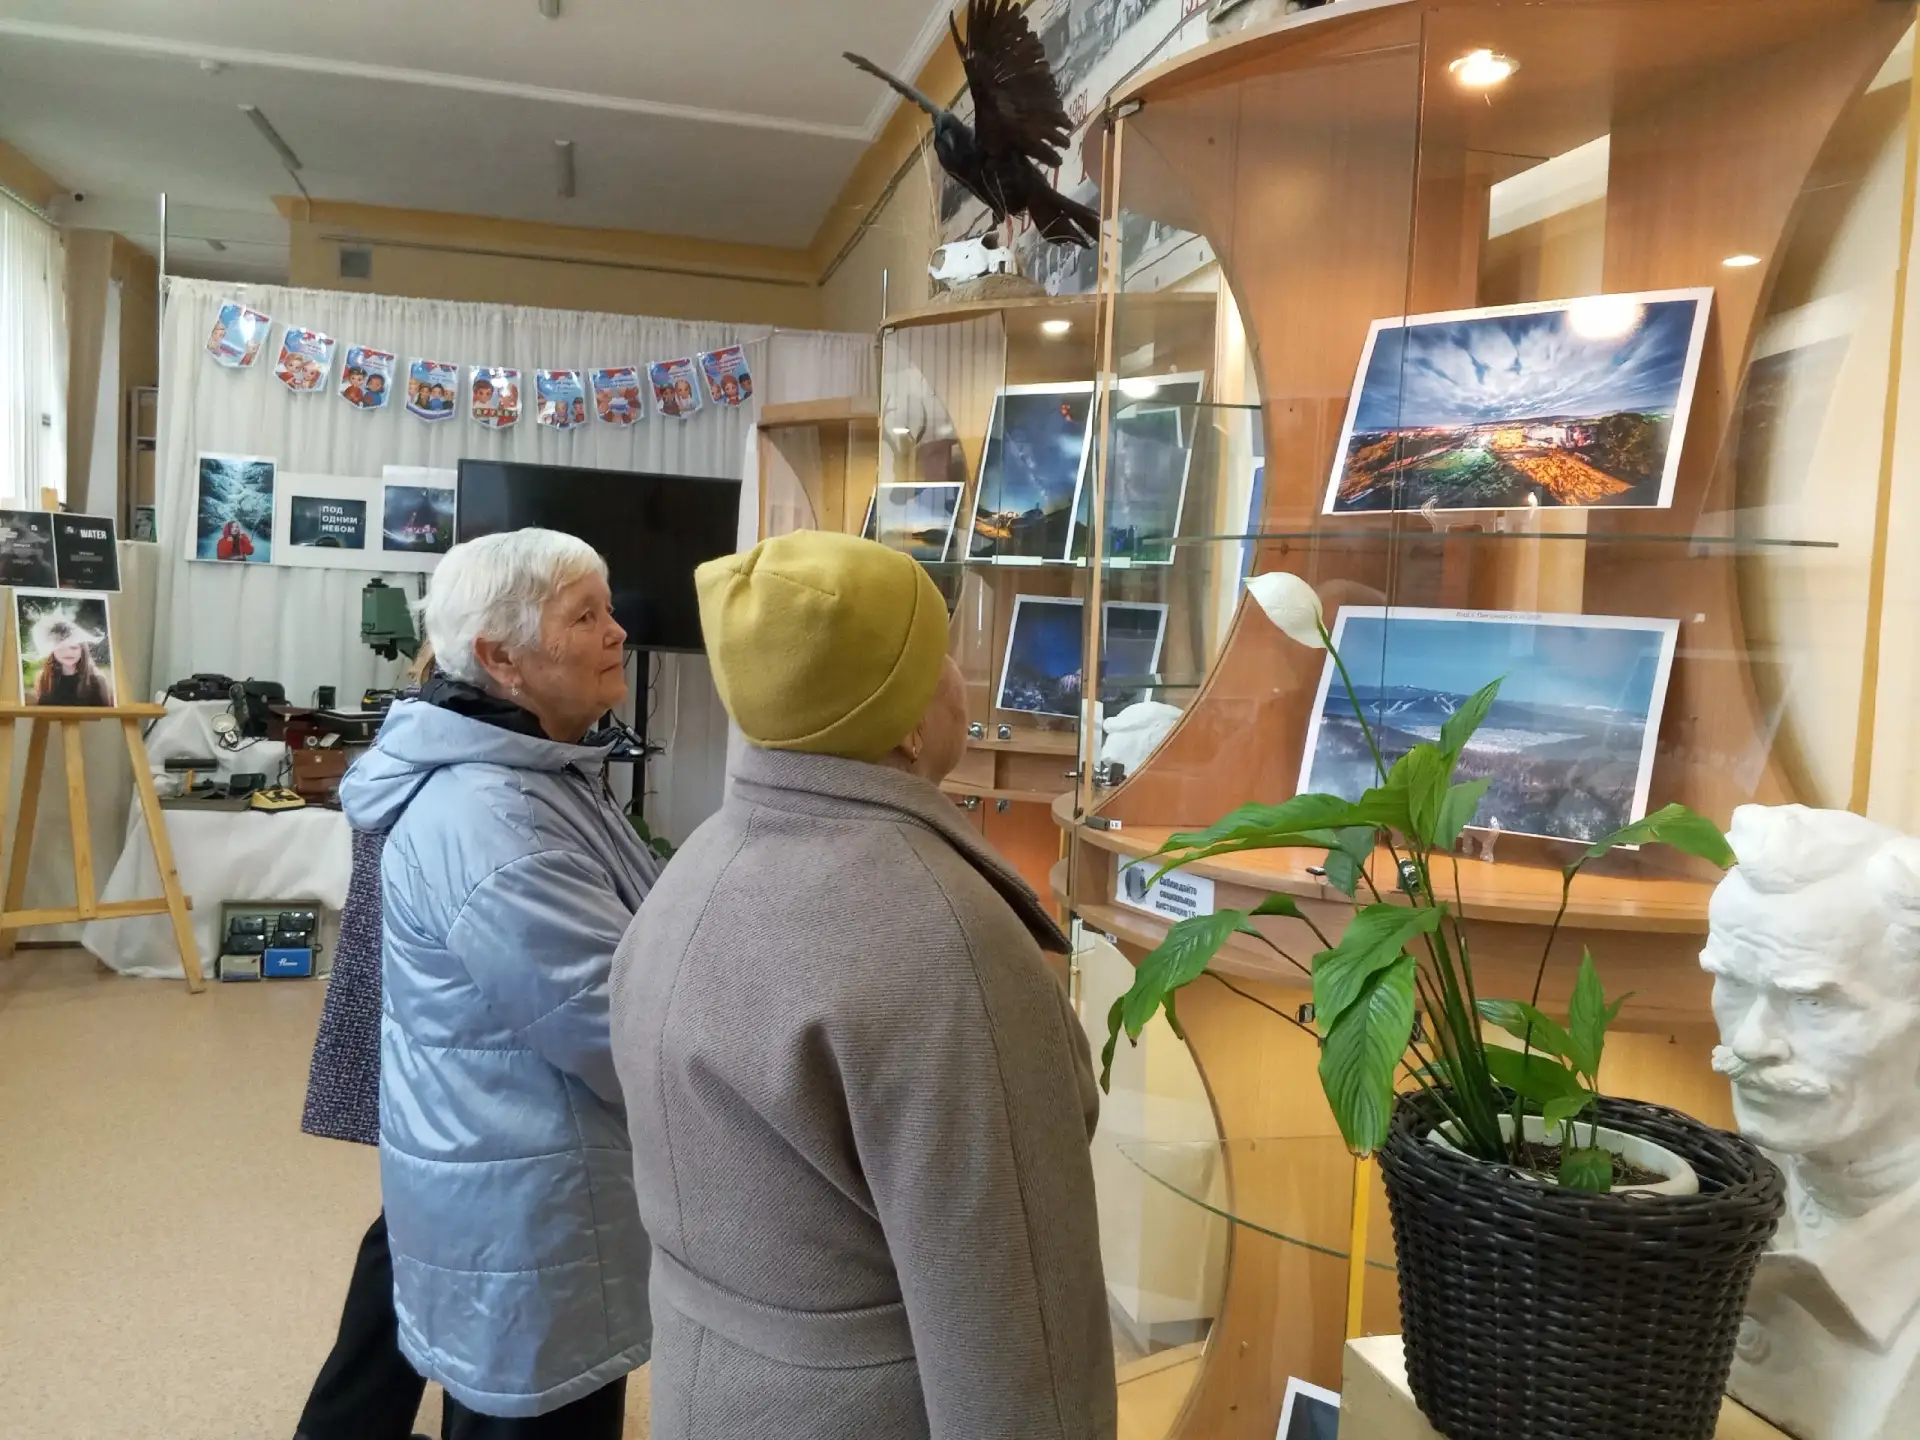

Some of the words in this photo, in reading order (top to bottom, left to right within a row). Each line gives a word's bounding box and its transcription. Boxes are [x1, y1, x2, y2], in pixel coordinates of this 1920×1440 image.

[322, 506, 344, 515] ПОД
[322, 516, 358, 524] ОДНИМ
[322, 525, 356, 533] НЕБОМ
[80, 529, 107, 540] WATER
